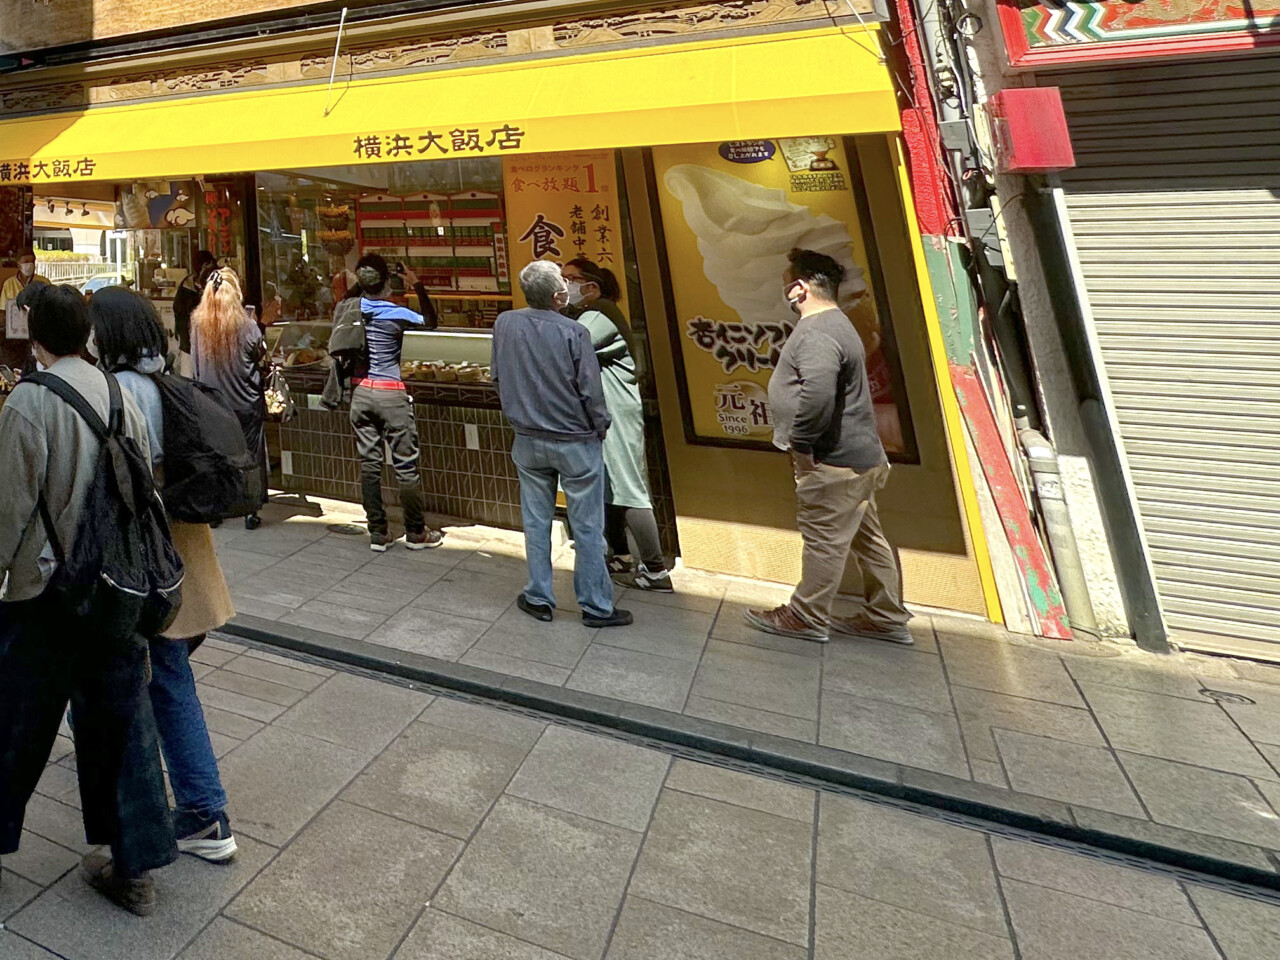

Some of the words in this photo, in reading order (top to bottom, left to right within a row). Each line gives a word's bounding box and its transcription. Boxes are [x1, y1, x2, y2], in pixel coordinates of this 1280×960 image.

[354, 125, 525, 159] 横浜大飯店
[511, 177, 580, 193] 食べ放題
[519, 214, 565, 268] 食
[591, 203, 614, 264] 創業六
[712, 343, 782, 374] クリー
[719, 412, 748, 424] Since
[723, 424, 749, 434] 1996
